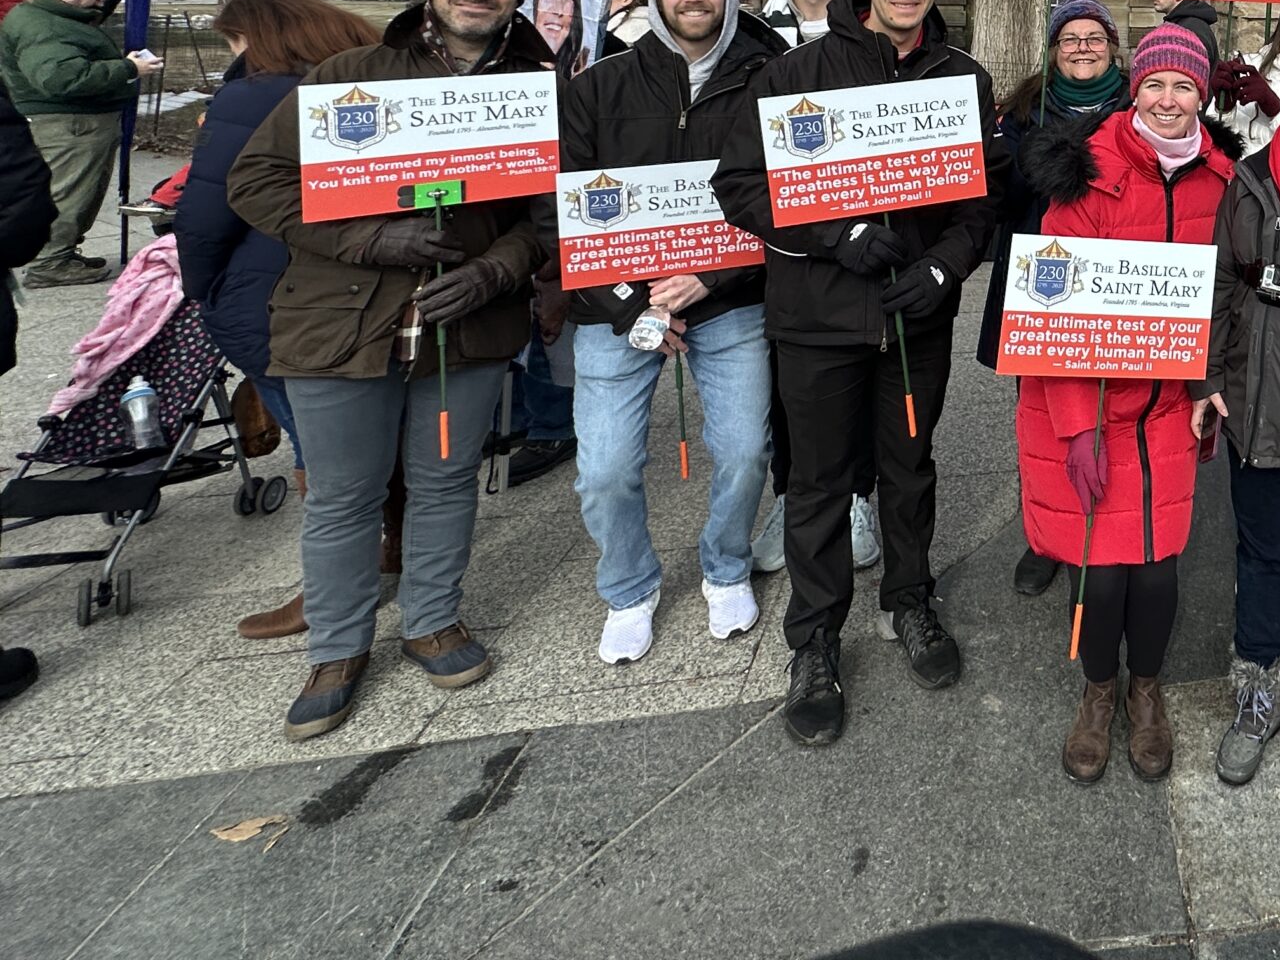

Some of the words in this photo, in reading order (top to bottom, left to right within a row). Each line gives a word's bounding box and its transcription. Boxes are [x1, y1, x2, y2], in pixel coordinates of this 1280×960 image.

[408, 96, 436, 108] THE
[441, 90, 529, 106] BASILICA
[534, 90, 550, 98] OF
[340, 111, 375, 126] 230
[410, 110, 477, 128] SAINT
[484, 104, 547, 121] MARY
[849, 110, 872, 121] THE
[877, 100, 950, 118] BASILICA
[955, 99, 968, 108] OF
[794, 120, 822, 136] 230
[852, 122, 907, 140] SAINT
[913, 114, 967, 132] MARY
[369, 158, 422, 172] formed
[425, 157, 447, 167] my
[450, 151, 496, 163] inmost
[499, 148, 539, 159] being;
[646, 184, 670, 194] THE
[776, 193, 816, 209] treat
[821, 188, 865, 203] every
[870, 180, 922, 195] human
[590, 193, 619, 208] 230
[648, 195, 703, 211] SAINT
[1038, 265, 1065, 280] 230
[1092, 262, 1114, 274] THE
[1118, 259, 1188, 278] BASILICA
[1192, 270, 1205, 279] OF
[1091, 276, 1144, 295] SAINT
[1149, 279, 1201, 298] MARY
[1049, 316, 1112, 330] ultimate
[1117, 319, 1145, 331] test
[1149, 319, 1166, 332] of
[1169, 323, 1202, 335] your
[1065, 360, 1091, 370] Saint
[1093, 360, 1119, 370] John
[1121, 361, 1143, 371] Paul
[1145, 362, 1153, 371] II
